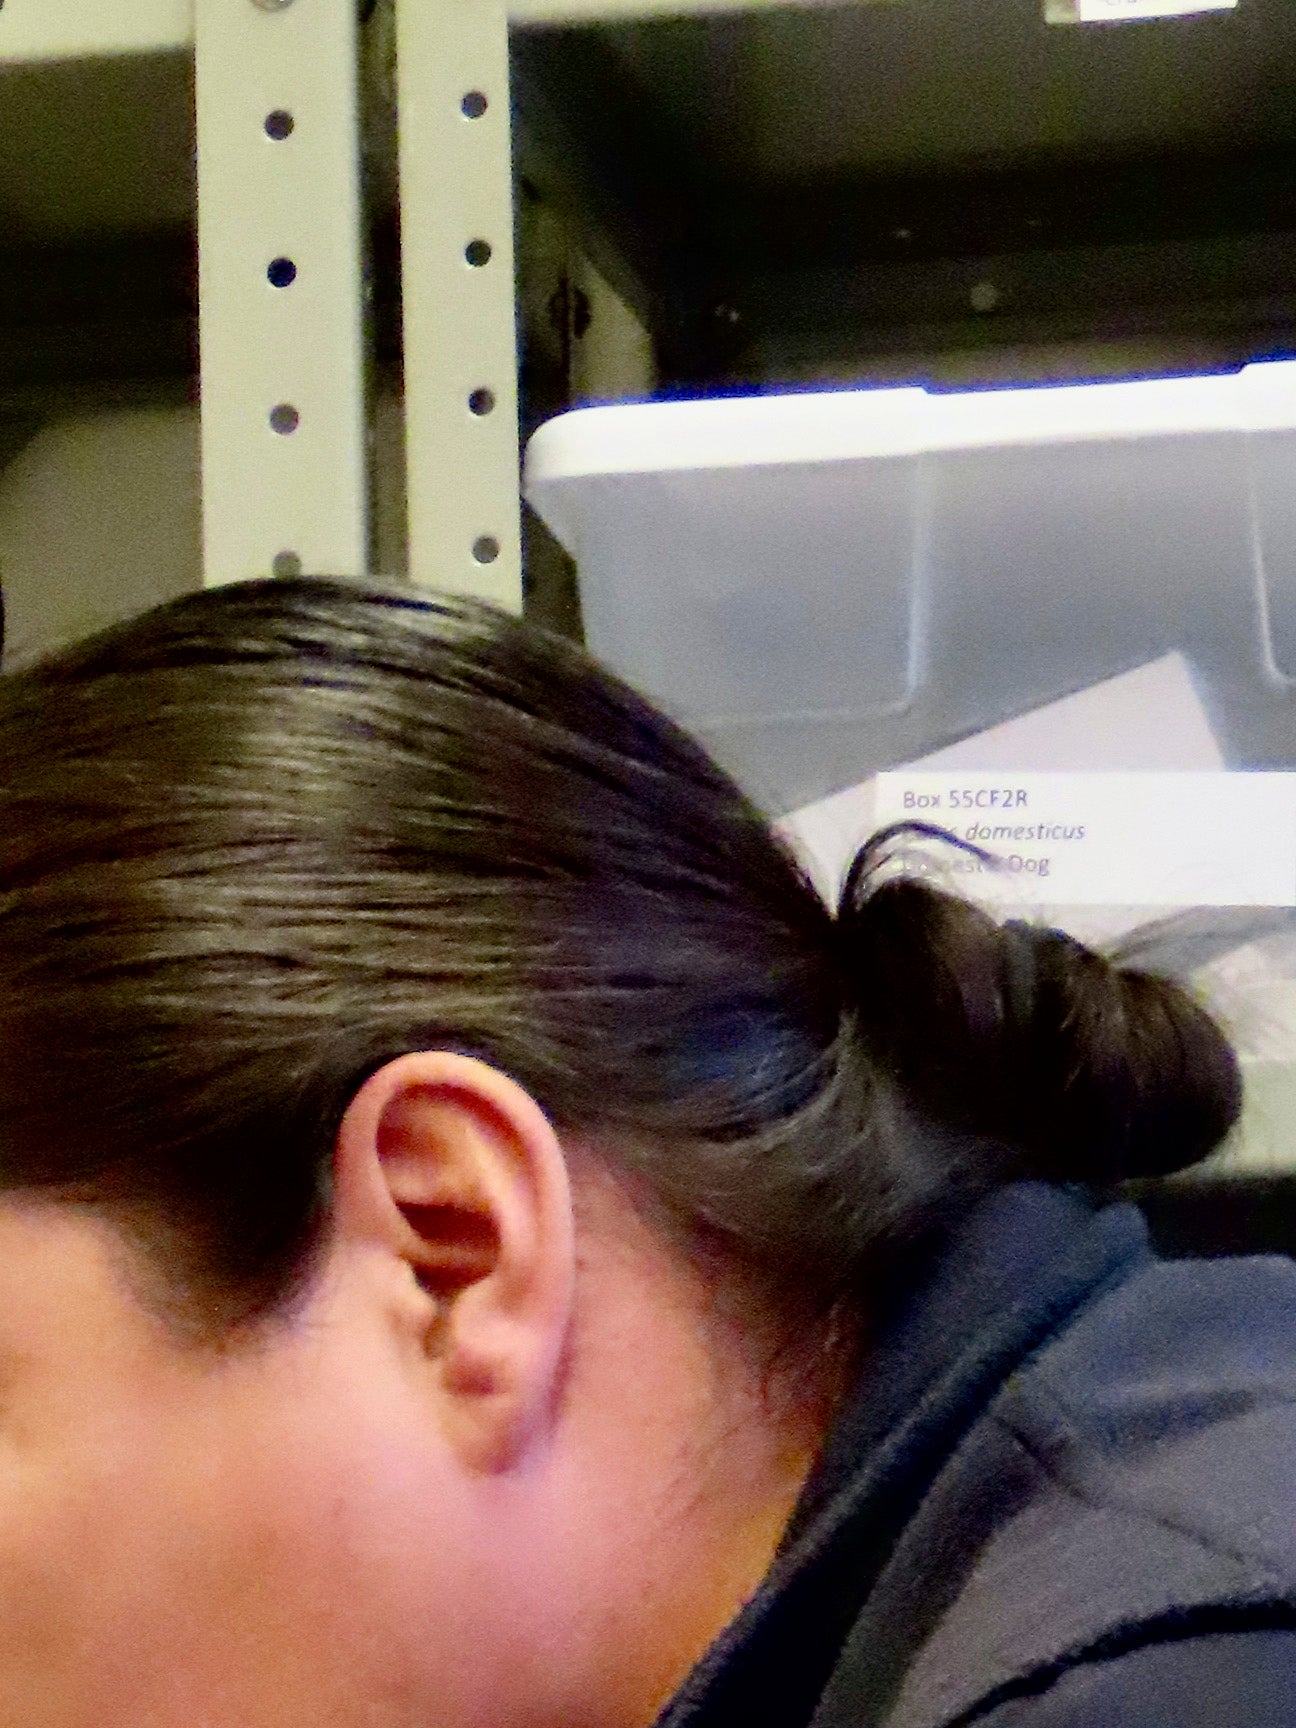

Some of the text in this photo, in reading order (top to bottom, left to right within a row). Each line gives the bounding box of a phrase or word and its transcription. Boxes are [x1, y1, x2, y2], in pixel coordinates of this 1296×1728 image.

[903, 790, 1028, 809] Box 55CF2R
[966, 822, 1086, 841] domesticus
